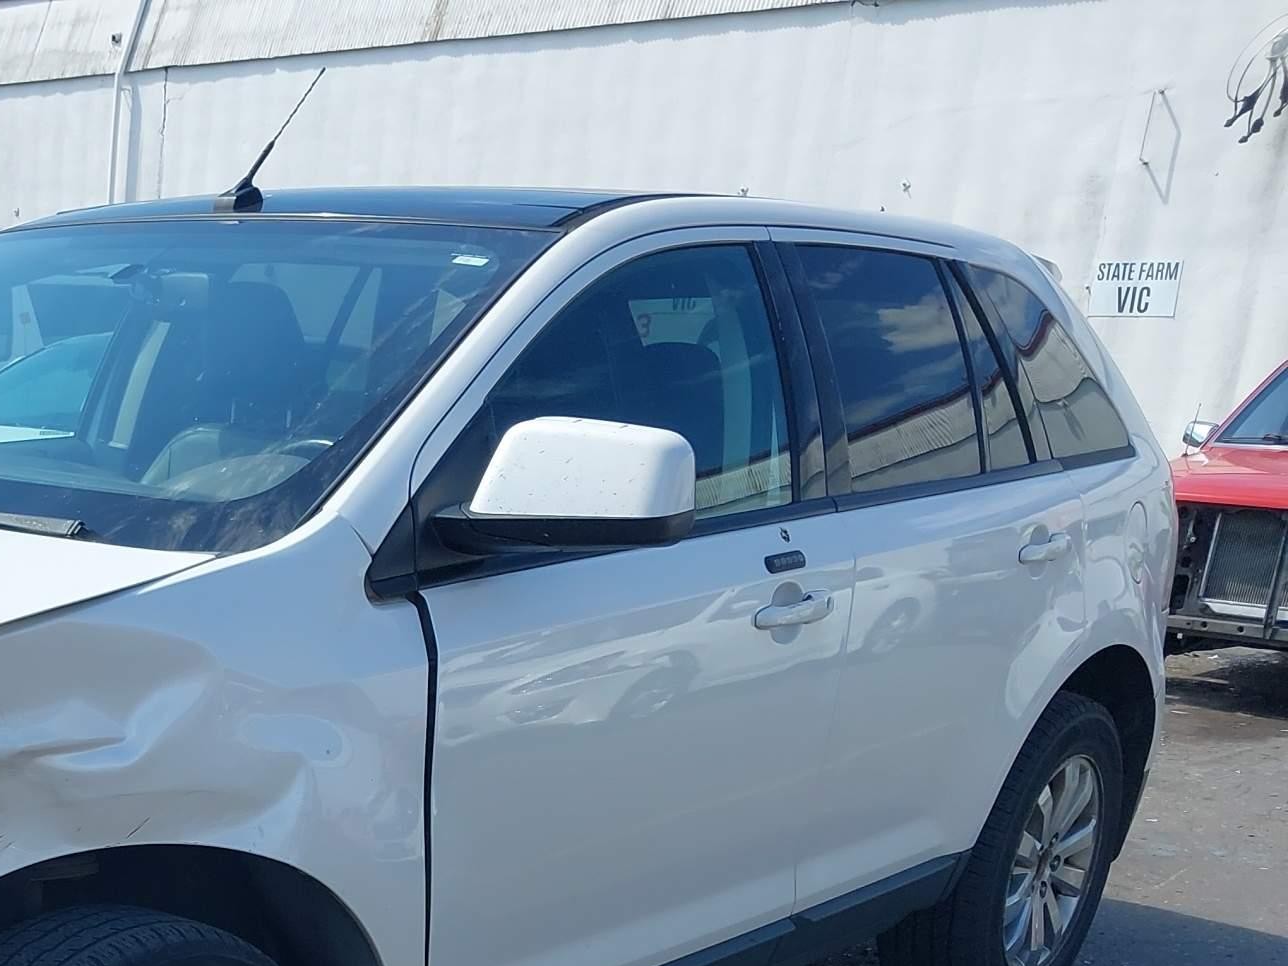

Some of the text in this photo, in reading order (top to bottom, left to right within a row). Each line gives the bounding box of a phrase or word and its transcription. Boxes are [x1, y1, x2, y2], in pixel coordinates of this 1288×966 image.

[1097, 262, 1180, 281] STATE FARM
[1117, 286, 1151, 313] VIC
